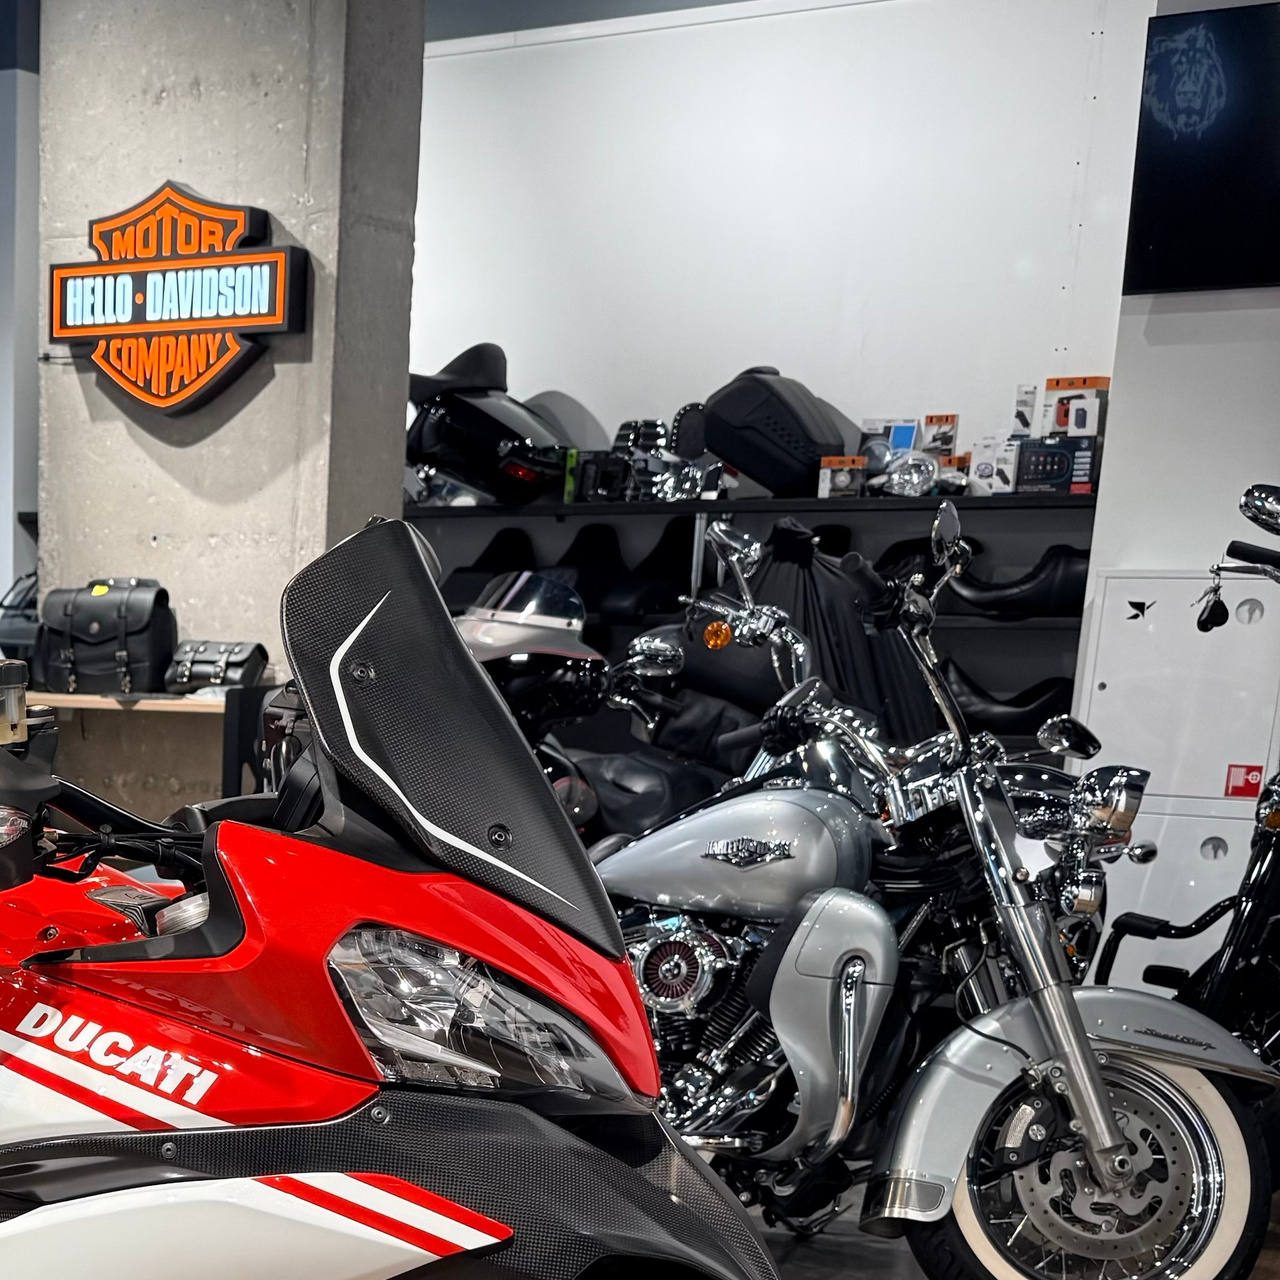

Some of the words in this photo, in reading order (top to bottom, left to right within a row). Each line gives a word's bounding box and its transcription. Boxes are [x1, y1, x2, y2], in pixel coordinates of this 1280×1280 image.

[112, 202, 224, 260] MOTOR
[66, 273, 133, 326] HELLO
[145, 264, 270, 321] DAVIDSON
[109, 332, 222, 396] COMPANY
[15, 1002, 219, 1105] DUCATI
